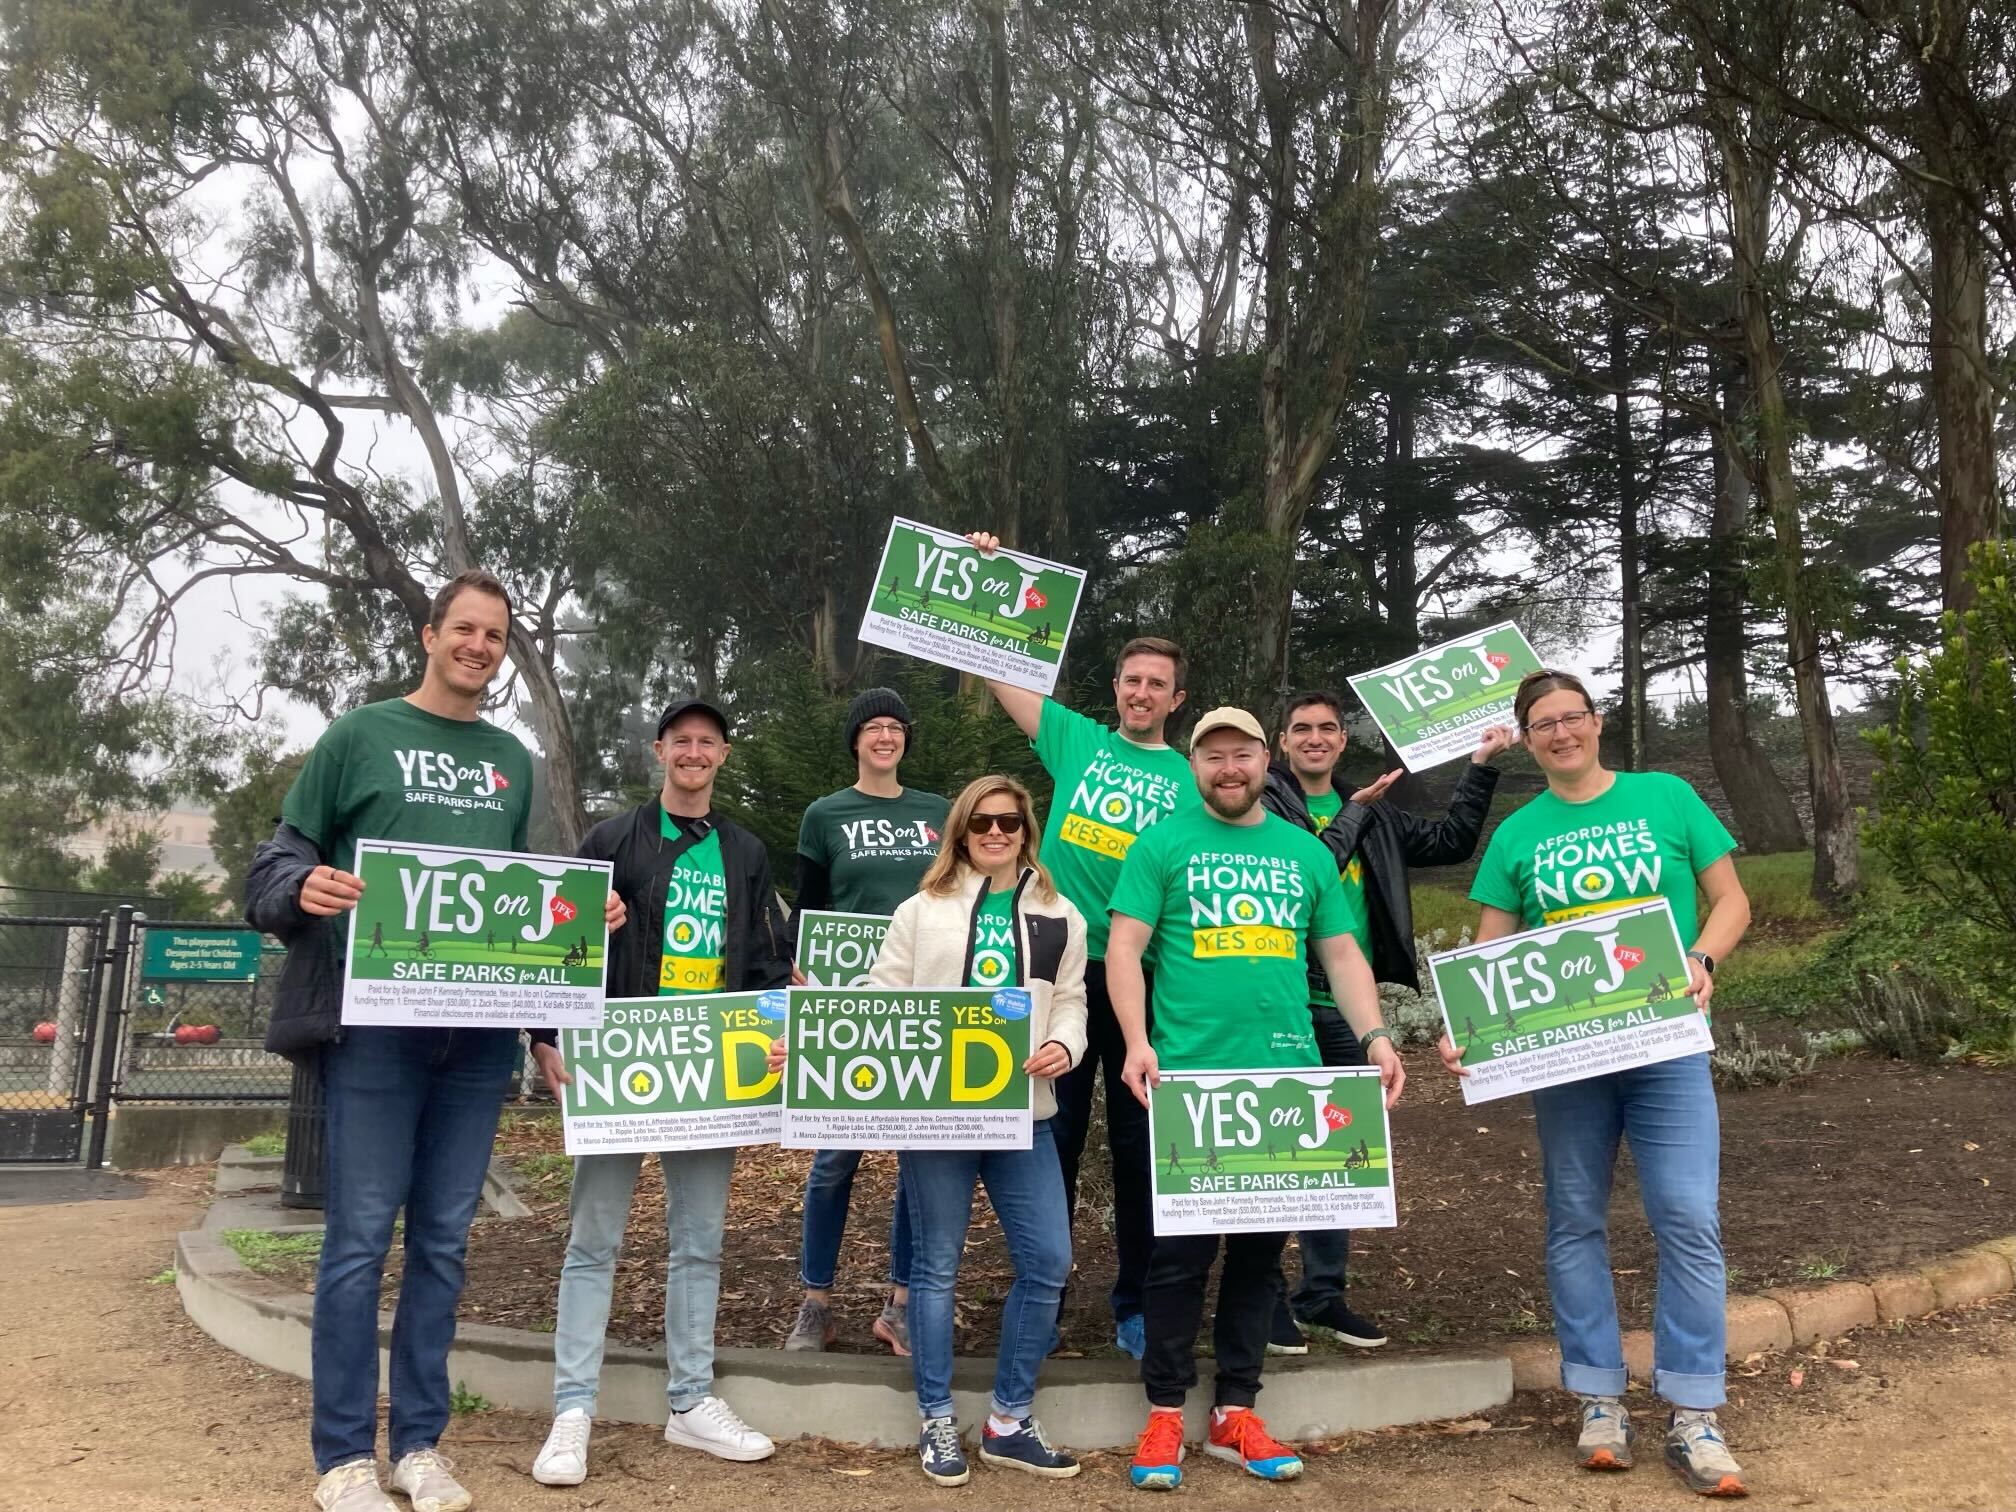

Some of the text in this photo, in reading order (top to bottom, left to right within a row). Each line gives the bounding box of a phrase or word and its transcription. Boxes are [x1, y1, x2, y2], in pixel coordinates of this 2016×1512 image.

[914, 542, 1039, 618] YES on J
[900, 608, 1032, 656] SAFE PARKS for ALL
[1380, 645, 1500, 712] YES on J
[1416, 720, 1454, 739] SAFE
[1453, 703, 1498, 726] PARKS
[393, 750, 497, 796] YES on J
[1096, 748, 1180, 792] AFORDABLE
[405, 792, 436, 804] SAFE
[438, 796, 472, 808] PARKS
[484, 800, 504, 812] ALL
[841, 819, 896, 850] YES
[894, 828, 918, 838] on
[911, 820, 930, 847] J
[1068, 818, 1103, 845] YES
[1535, 818, 1648, 853] AFFORDABLE
[851, 850, 877, 860] SAFE
[1190, 852, 1300, 872] AFFORDABLE
[1534, 832, 1657, 874] HOMES
[1188, 866, 1304, 898] HOMES
[1536, 856, 1662, 912] NOW
[400, 868, 563, 942] YES on J
[552, 901, 573, 920] JFK
[1188, 894, 1302, 928] NOW
[173, 936, 188, 946] This
[188, 937, 230, 947] playground
[811, 922, 888, 940] AFFORD
[1200, 931, 1296, 952] YES ON D
[165, 948, 242, 959] Designed for Children
[170, 961, 188, 970] Ages
[223, 961, 236, 969] Old
[1617, 950, 1641, 963] JFK
[392, 962, 570, 984] SAFE PARKS for ALL
[684, 970, 709, 984] ON
[1468, 931, 1625, 1016] YES on J
[720, 1008, 773, 1028] YES ON
[800, 998, 940, 1014] AFFORDABLE
[952, 1006, 992, 1024] YES
[572, 1024, 714, 1058] HOMES
[798, 1018, 942, 1050] HOMES
[1492, 1006, 1662, 1056] SAFE PARKS for ALL
[722, 1030, 782, 1100] D
[798, 1054, 942, 1101] NOW
[951, 1028, 1014, 1102] D
[575, 1058, 714, 1106] NOW
[1183, 1090, 1332, 1148] YES on J
[1325, 1108, 1347, 1125] JFK
[1190, 1172, 1356, 1192] SAFE PARKS for ALL
